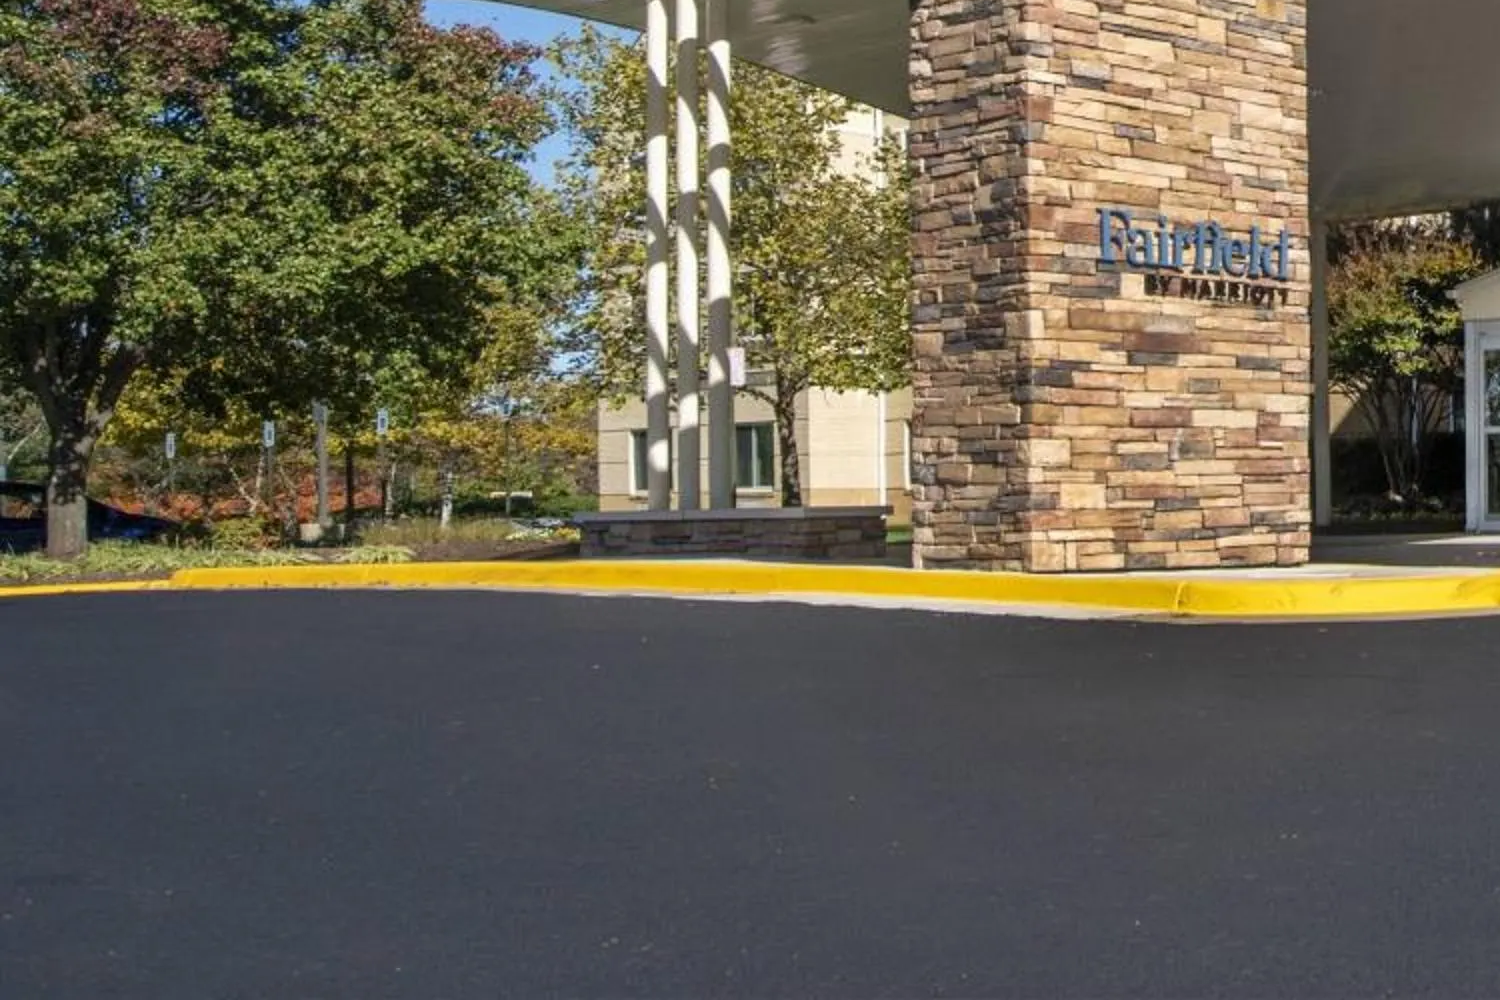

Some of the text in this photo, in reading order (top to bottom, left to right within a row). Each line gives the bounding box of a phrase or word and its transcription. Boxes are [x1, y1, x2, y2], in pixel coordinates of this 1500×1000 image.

[1097, 208, 1292, 281] Fairfield
[1144, 273, 1288, 309] BY MARRIOTT
